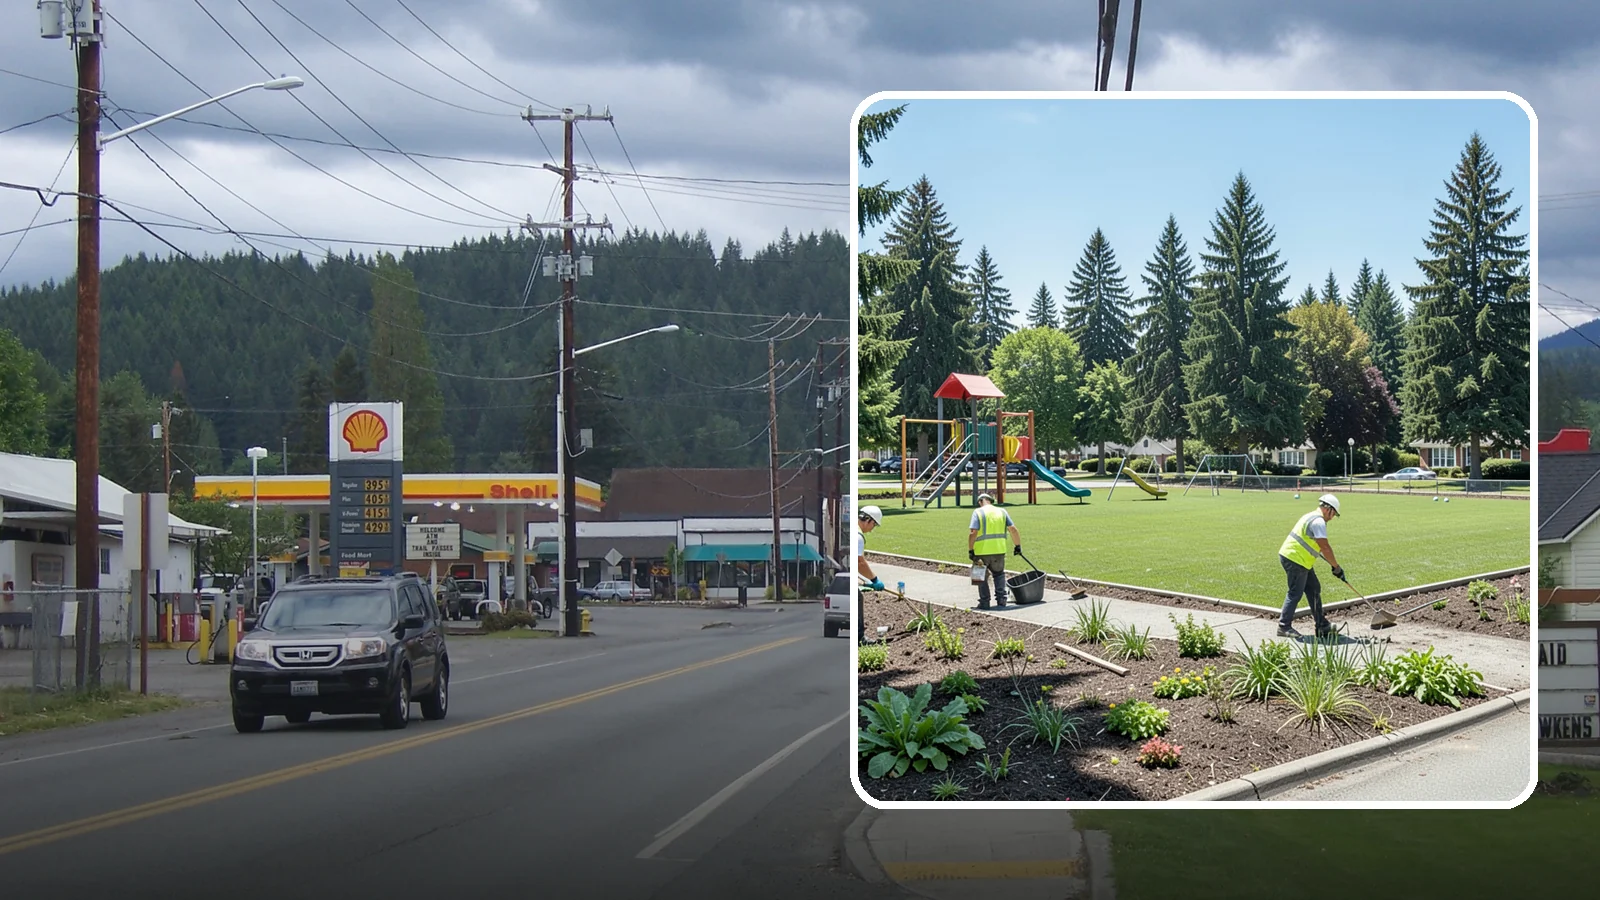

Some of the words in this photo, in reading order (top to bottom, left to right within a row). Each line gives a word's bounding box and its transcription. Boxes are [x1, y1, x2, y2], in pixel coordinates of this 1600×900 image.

[366, 480, 383, 490] 395
[490, 484, 547, 499] Shell
[366, 494, 383, 504] 405
[366, 508, 383, 518] 415
[366, 522, 383, 532] 429
